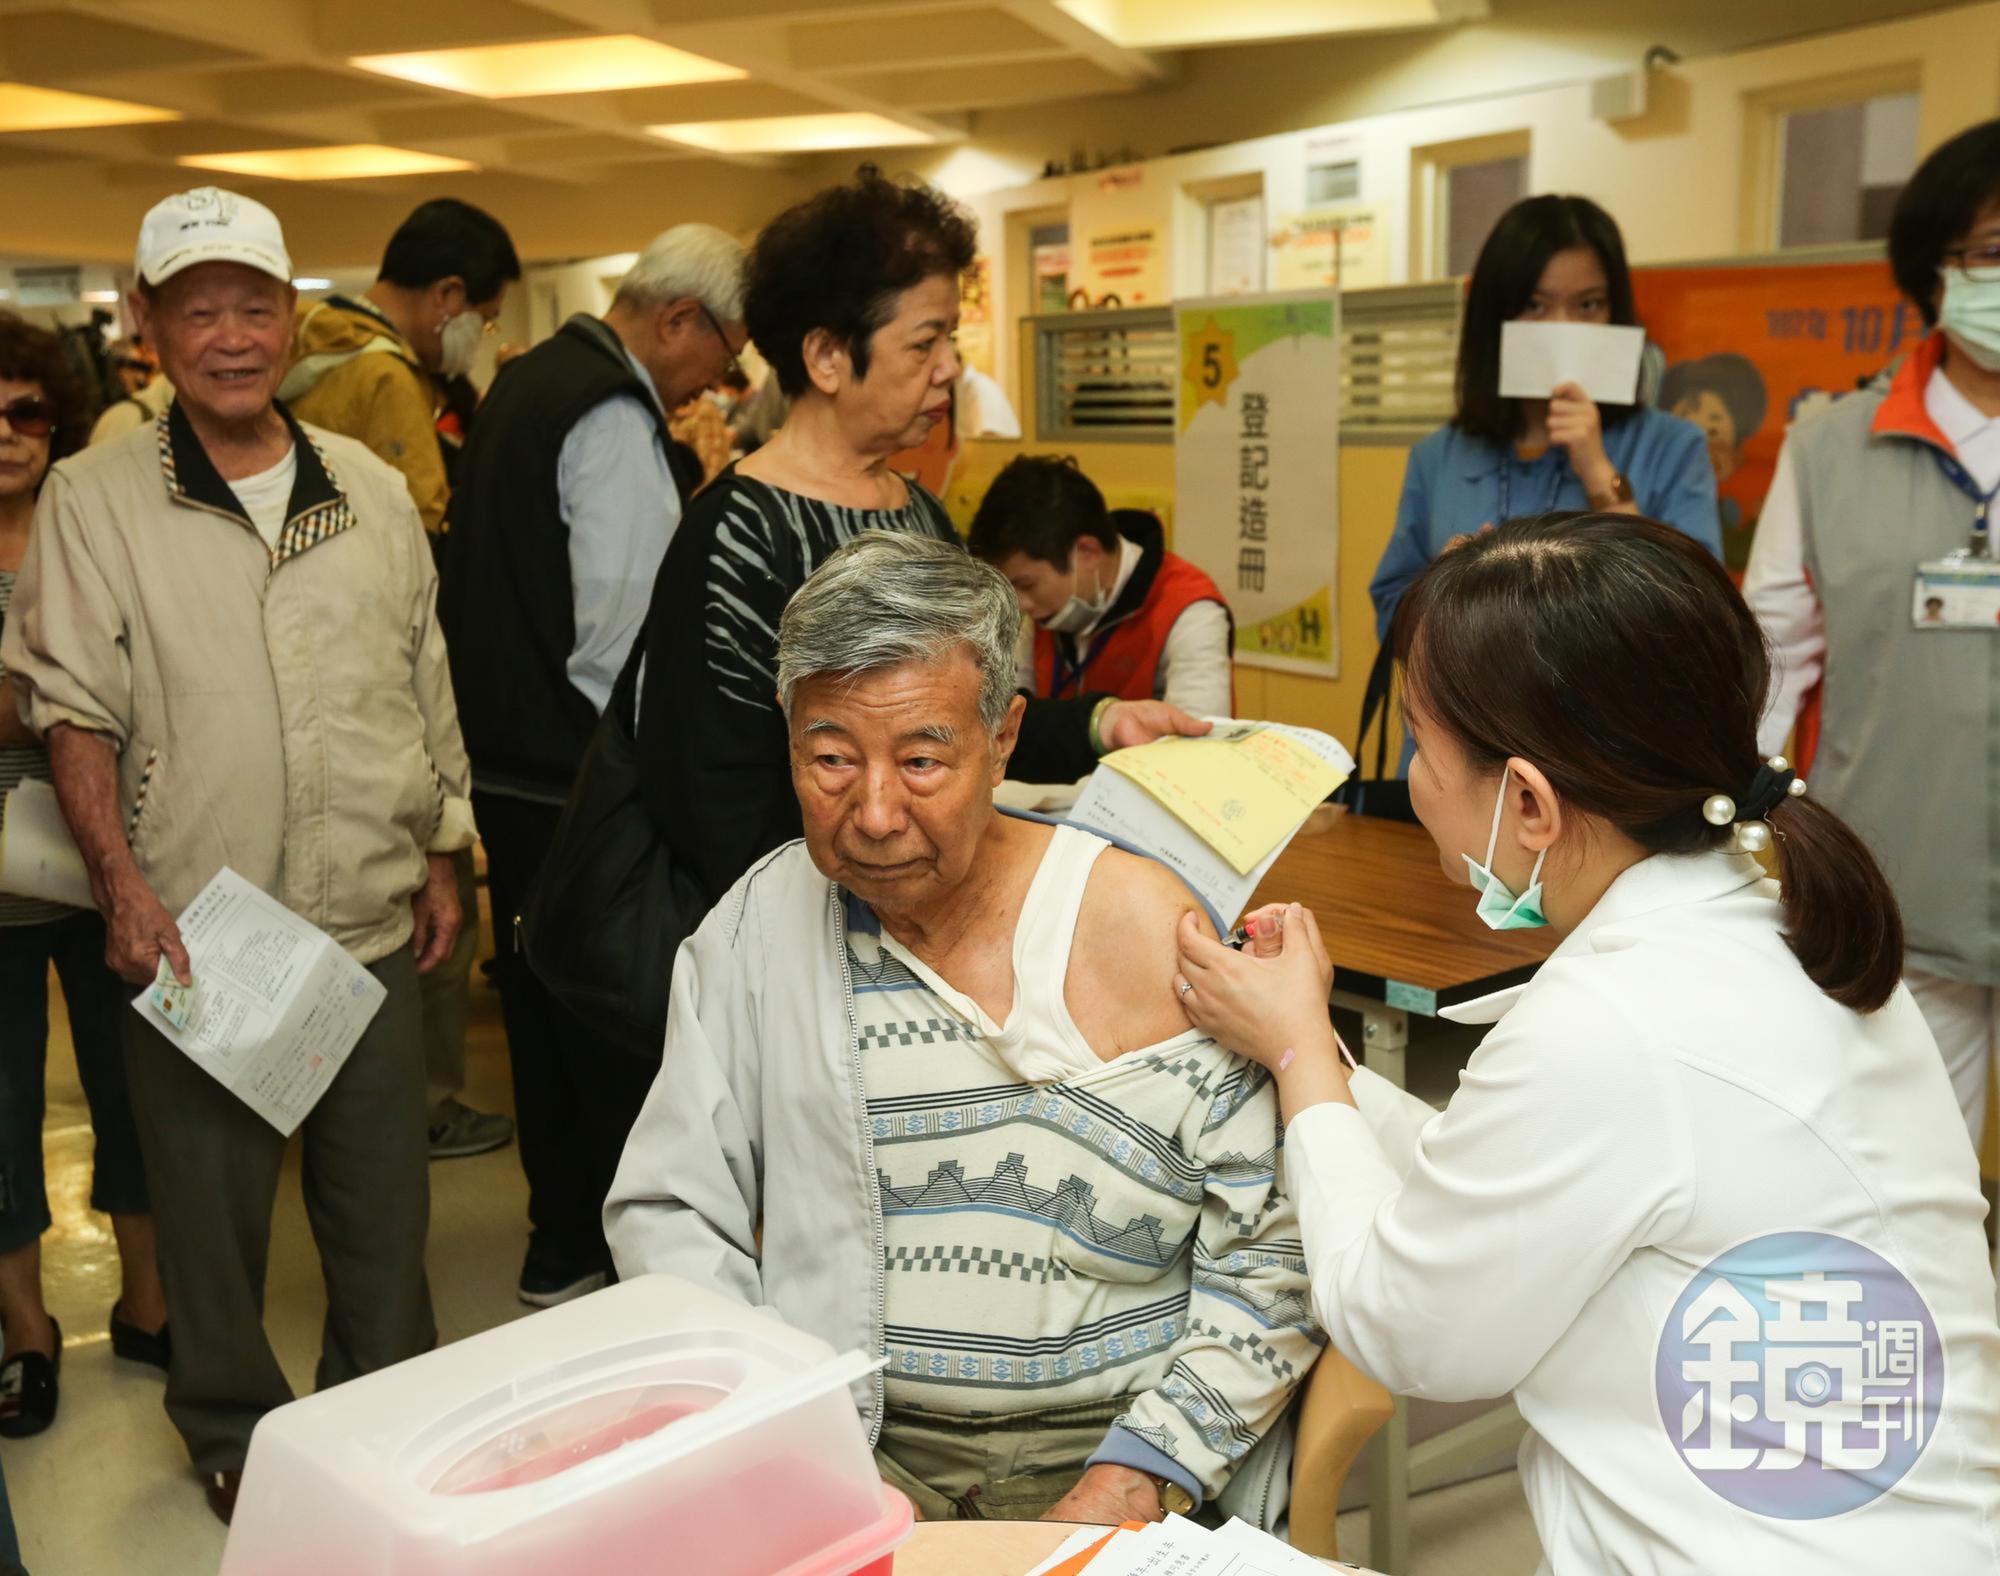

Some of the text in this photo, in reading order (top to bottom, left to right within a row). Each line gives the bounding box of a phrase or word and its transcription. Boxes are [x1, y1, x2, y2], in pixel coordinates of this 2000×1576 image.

[1203, 343, 1223, 389] 5
[1238, 392, 1270, 593] 登記造冊
